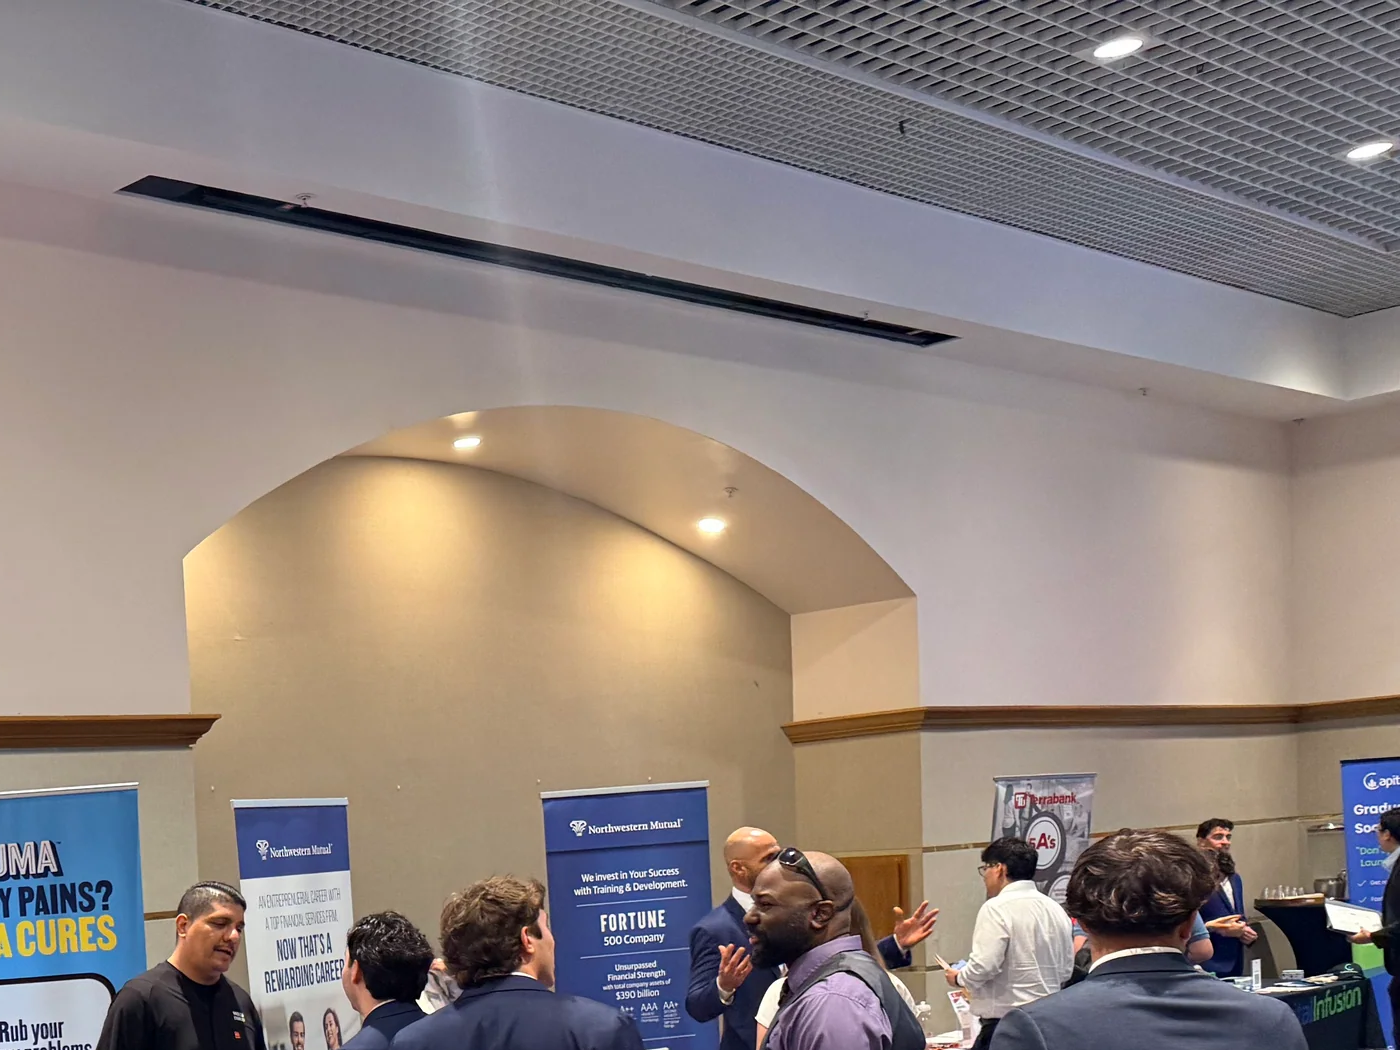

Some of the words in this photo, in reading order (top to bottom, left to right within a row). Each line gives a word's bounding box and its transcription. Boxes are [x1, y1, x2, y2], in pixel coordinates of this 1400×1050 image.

[1029, 792, 1077, 805] Terrabank
[588, 823, 648, 834] Northwestern
[650, 819, 681, 830] Mutual
[270, 845, 311, 858] Northwestern
[312, 843, 332, 855] Mutual
[581, 874, 595, 883] We
[595, 872, 619, 881] invest
[620, 871, 628, 880] in
[629, 870, 647, 878] Your
[648, 868, 679, 877] Success
[574, 887, 591, 896] with
[593, 885, 624, 894] Training
[625, 883, 631, 892] &
[633, 879, 688, 891] Development.
[18, 880, 113, 917] PAINS?
[600, 909, 666, 932] FORTUNE
[16, 914, 118, 957] CURES
[604, 935, 622, 946] 500
[623, 934, 664, 944] Company
[276, 938, 296, 961] NOW
[298, 933, 325, 958] THAT'S
[327, 932, 332, 953] A
[615, 960, 657, 971] Unsurpassed
[264, 964, 314, 993] REWARDING
[607, 972, 636, 981] Financial
[637, 969, 666, 978] Strength
[616, 990, 636, 1000] $390
[637, 989, 660, 998] billion
[641, 1002, 658, 1011] AAA
[33, 1021, 64, 1045] your
